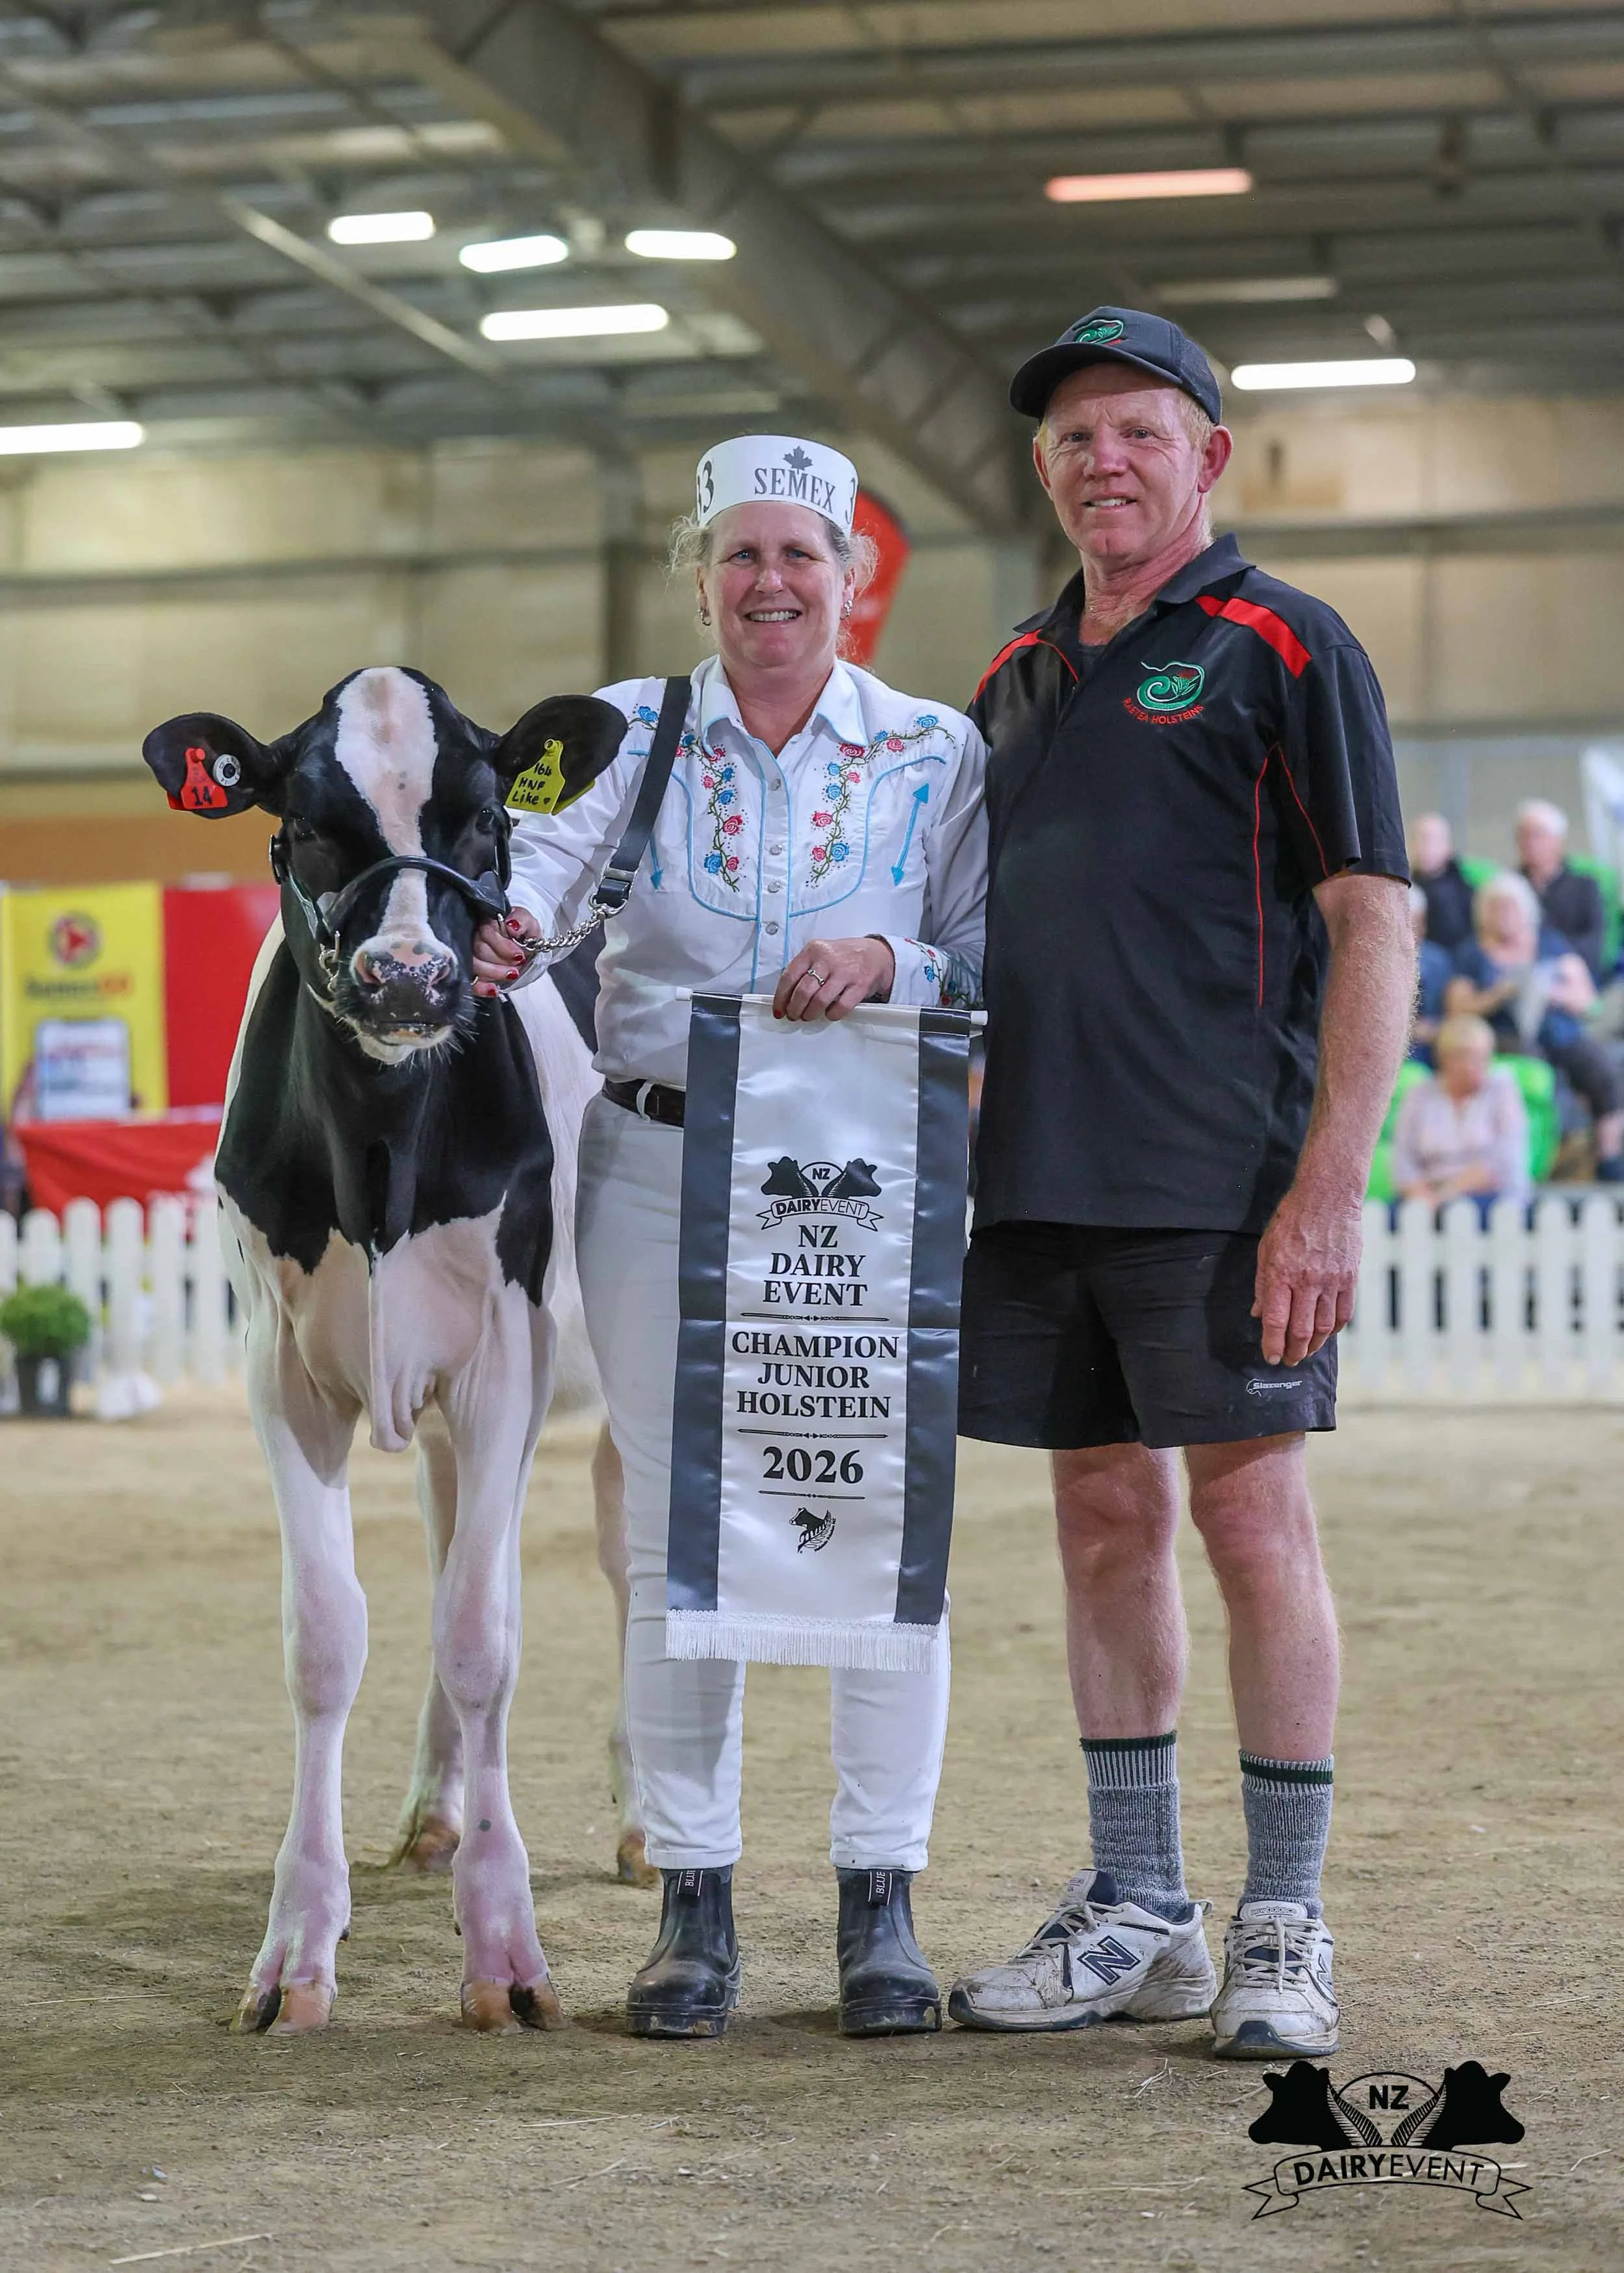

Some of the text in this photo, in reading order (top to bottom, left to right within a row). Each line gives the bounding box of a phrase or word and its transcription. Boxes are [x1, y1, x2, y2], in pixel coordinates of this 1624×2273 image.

[754, 468, 836, 514] SEMEX
[1152, 704, 1204, 725] HOLSTEINS
[192, 785, 213, 806] 14
[512, 789, 539, 806] Like
[812, 1168, 830, 1180] NZ
[798, 1225, 838, 1248] NZ
[769, 1252, 867, 1277] DAIRY
[763, 1280, 868, 1306] EVENT
[732, 1331, 899, 1358] CHAMPION
[757, 1362, 870, 1389] JUNIOR
[1252, 1380, 1302, 1390] Slazenger
[737, 1391, 892, 1418] HOLSTEIN
[763, 1446, 863, 1484] 2026
[876, 1872, 885, 1894] BLUE
[1077, 1935, 1141, 1986] N
